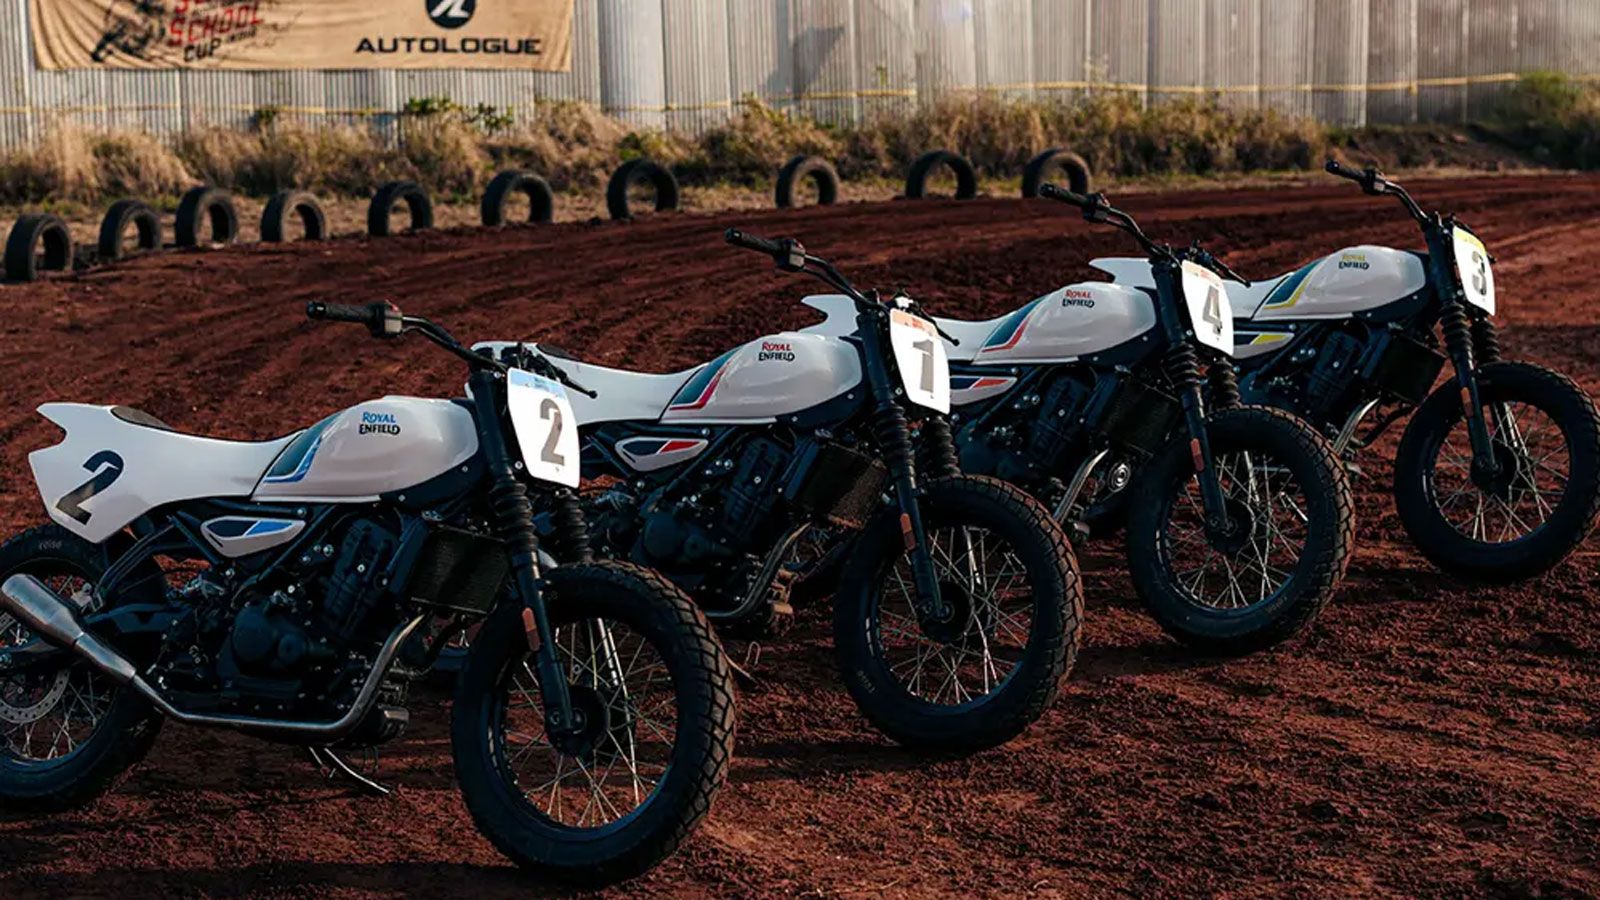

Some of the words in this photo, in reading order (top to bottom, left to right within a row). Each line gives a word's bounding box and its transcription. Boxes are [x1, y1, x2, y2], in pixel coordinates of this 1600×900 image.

[168, 1, 263, 46] SCHOOL
[183, 38, 221, 62] CUP
[355, 37, 541, 54] AUTOLOGUE
[1472, 250, 1487, 295] 3
[1202, 285, 1223, 336] 4
[758, 351, 796, 362] ENFIELD
[761, 341, 793, 351] ROYAL
[912, 339, 934, 393] 1
[359, 423, 401, 435] ENFIELD
[362, 411, 397, 423] ROYAL
[540, 398, 565, 466] 2
[55, 450, 124, 526] 2
